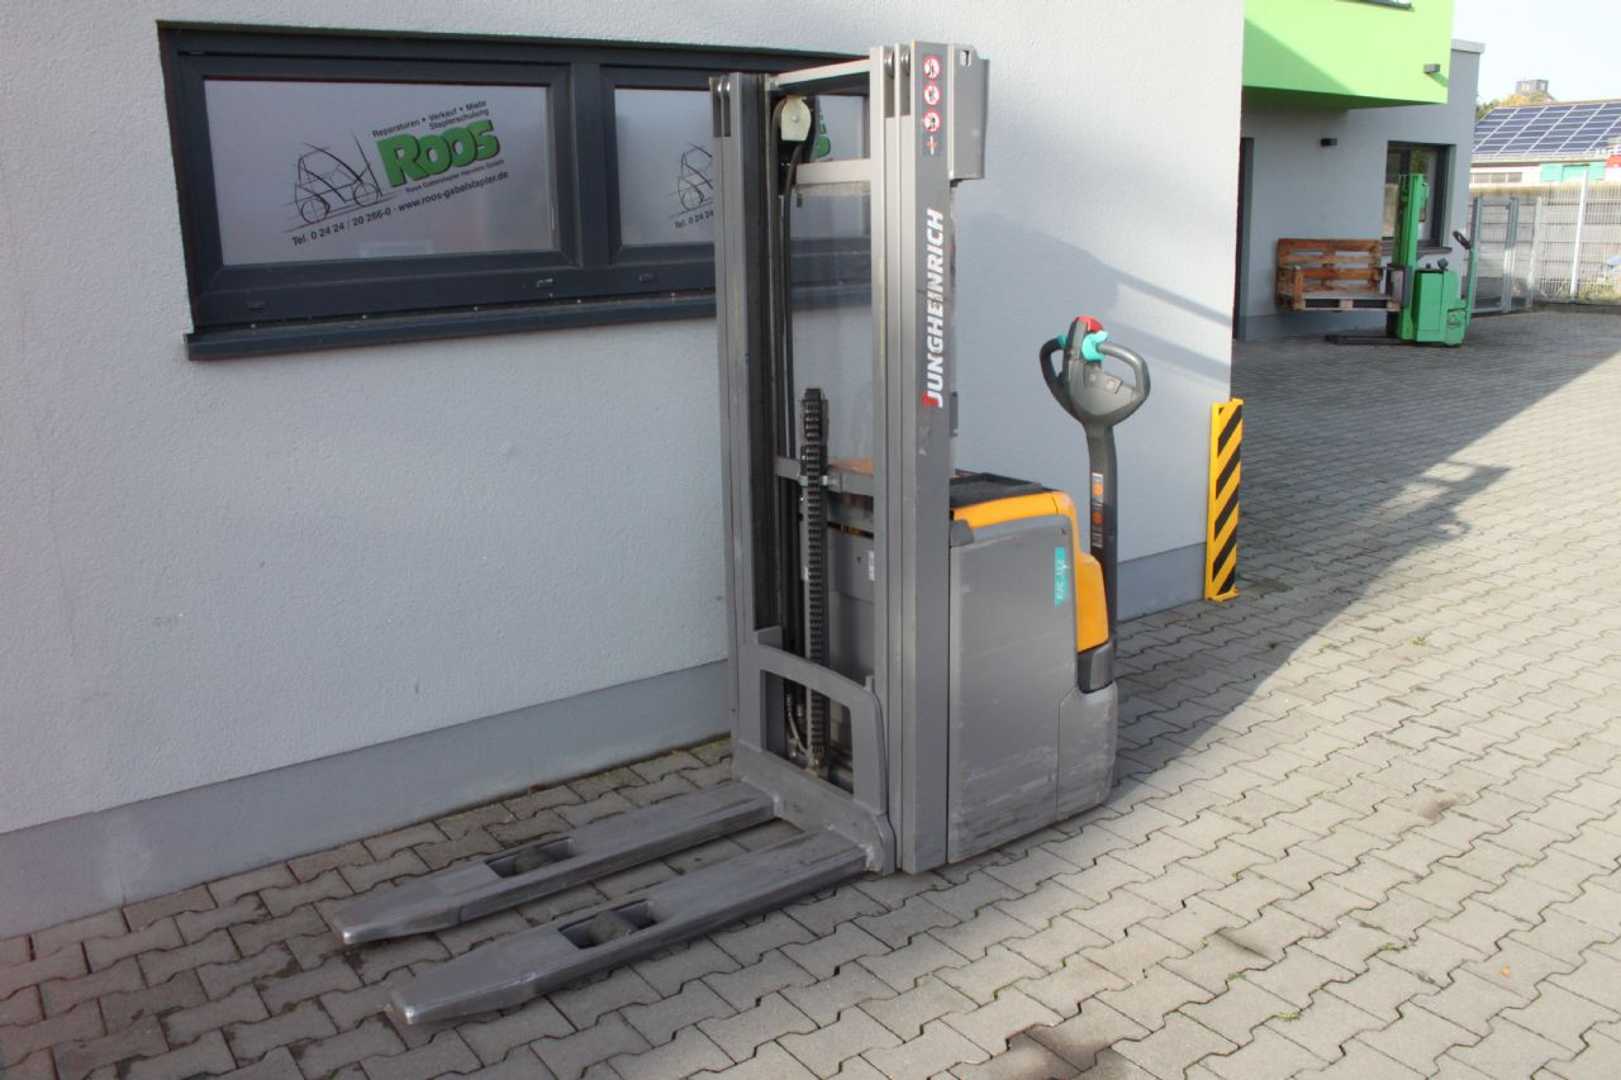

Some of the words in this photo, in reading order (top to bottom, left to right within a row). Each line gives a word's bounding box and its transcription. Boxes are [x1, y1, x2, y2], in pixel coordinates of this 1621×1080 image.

[429, 107, 457, 121] Verkauf
[311, 231, 317, 239] 0
[319, 226, 331, 237] 24
[332, 222, 345, 233] 24
[353, 215, 364, 226] 20
[923, 207, 943, 408] JUNGHEINRICH
